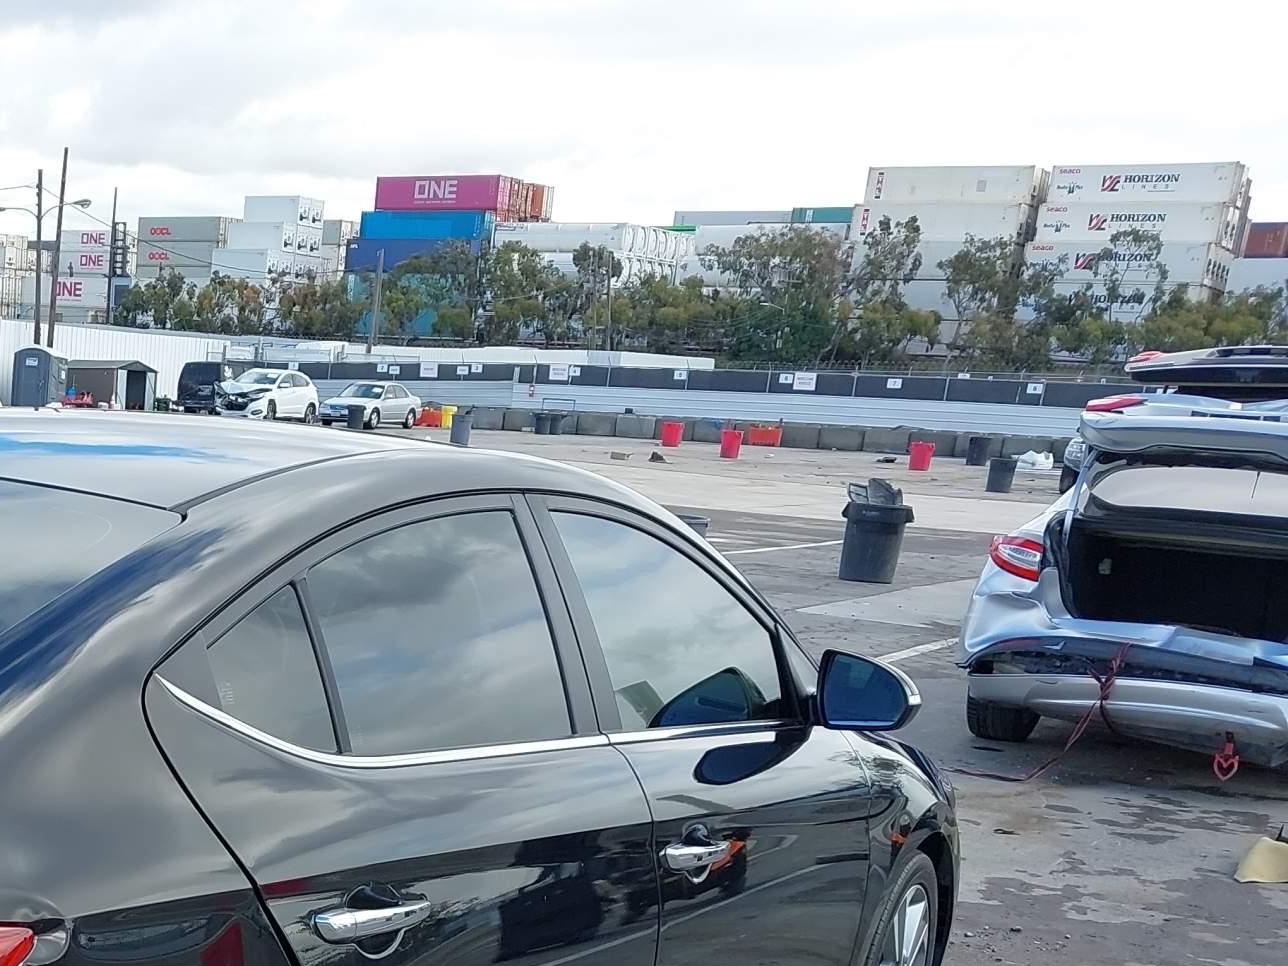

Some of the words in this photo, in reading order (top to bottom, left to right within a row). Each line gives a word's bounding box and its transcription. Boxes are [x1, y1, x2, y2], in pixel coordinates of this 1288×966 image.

[1123, 173, 1181, 183] HORIZON
[413, 180, 458, 199] ONE
[1109, 213, 1167, 223] HORIZON
[150, 227, 172, 236] OOCL
[81, 232, 105, 245] ONE
[80, 254, 104, 267] ONE
[148, 251, 170, 261] OOCL
